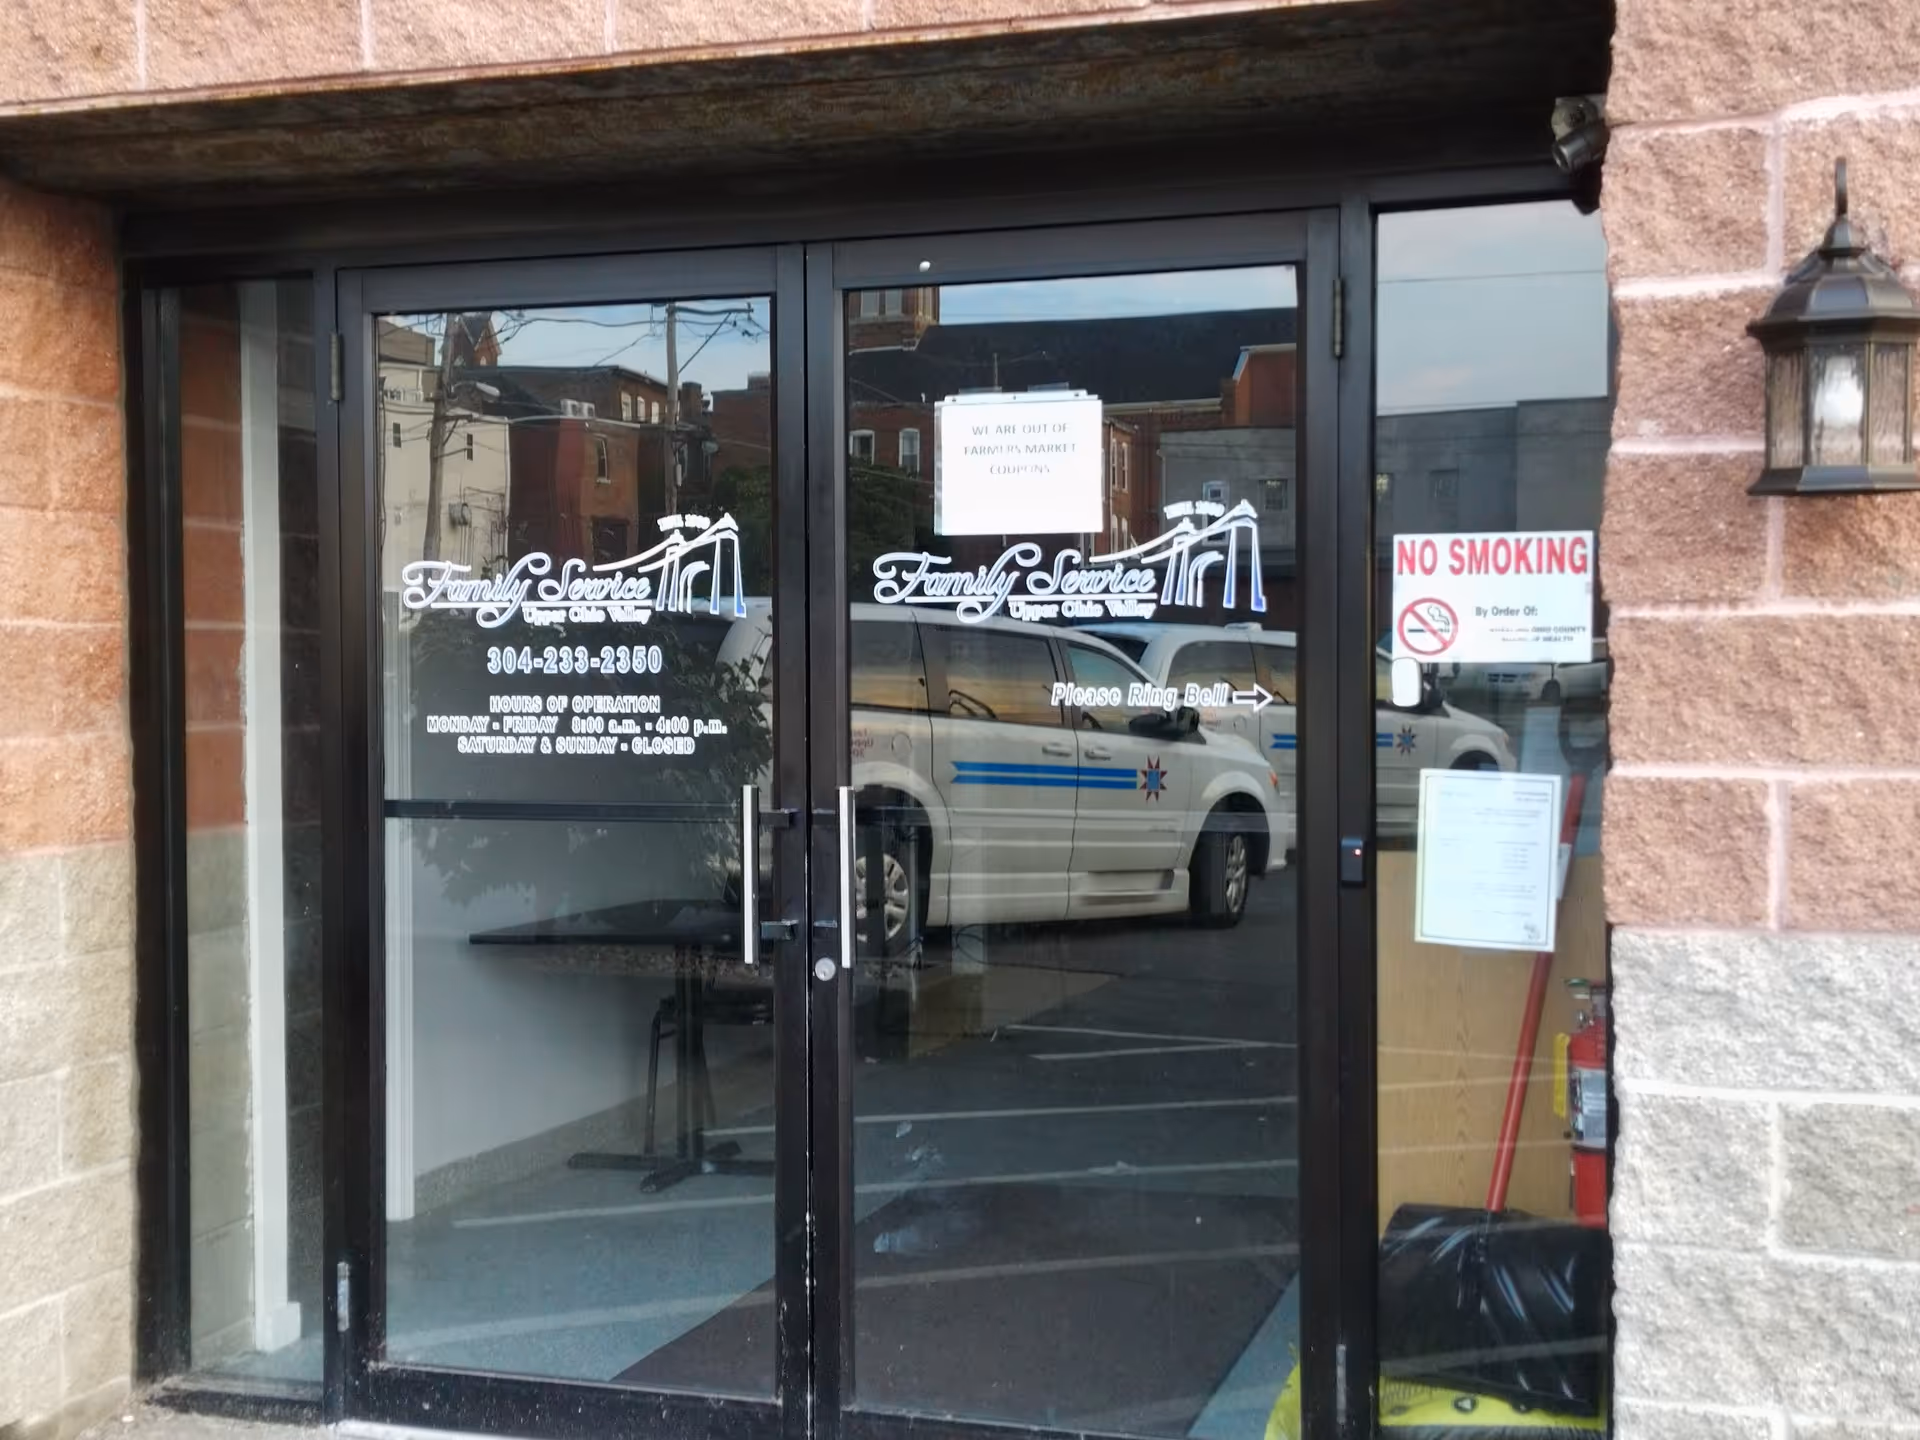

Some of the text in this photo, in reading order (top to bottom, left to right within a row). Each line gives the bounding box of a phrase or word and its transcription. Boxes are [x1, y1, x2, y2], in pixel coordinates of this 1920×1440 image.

[971, 422, 1070, 436] WE ARE OUT OF
[1025, 443, 1077, 454] MARKET
[989, 464, 1050, 476] COUPONS
[1397, 536, 1588, 576] NO SMOKING
[402, 552, 653, 628] Family Service
[873, 542, 1158, 623] Family Service
[521, 606, 653, 626] Upper Ohio Valley
[1008, 600, 1158, 621] Upper Ohio Valley
[1475, 605, 1539, 618] By Order Of:
[486, 645, 663, 675] 304-233-2350
[489, 694, 661, 714] HOURS OF OPERATION
[1050, 682, 1230, 711] Please Ring Bell
[426, 715, 491, 733] MONDAY
[502, 716, 559, 733] FRIDAY
[571, 716, 605, 734] 8:00
[607, 719, 641, 734] a.m.
[655, 716, 690, 734] 4:00
[693, 718, 728, 735] p.m.
[457, 736, 536, 754] SATURDAY
[540, 736, 553, 754] &
[555, 736, 619, 754] SUNDAY
[631, 736, 696, 754] CLOSED
